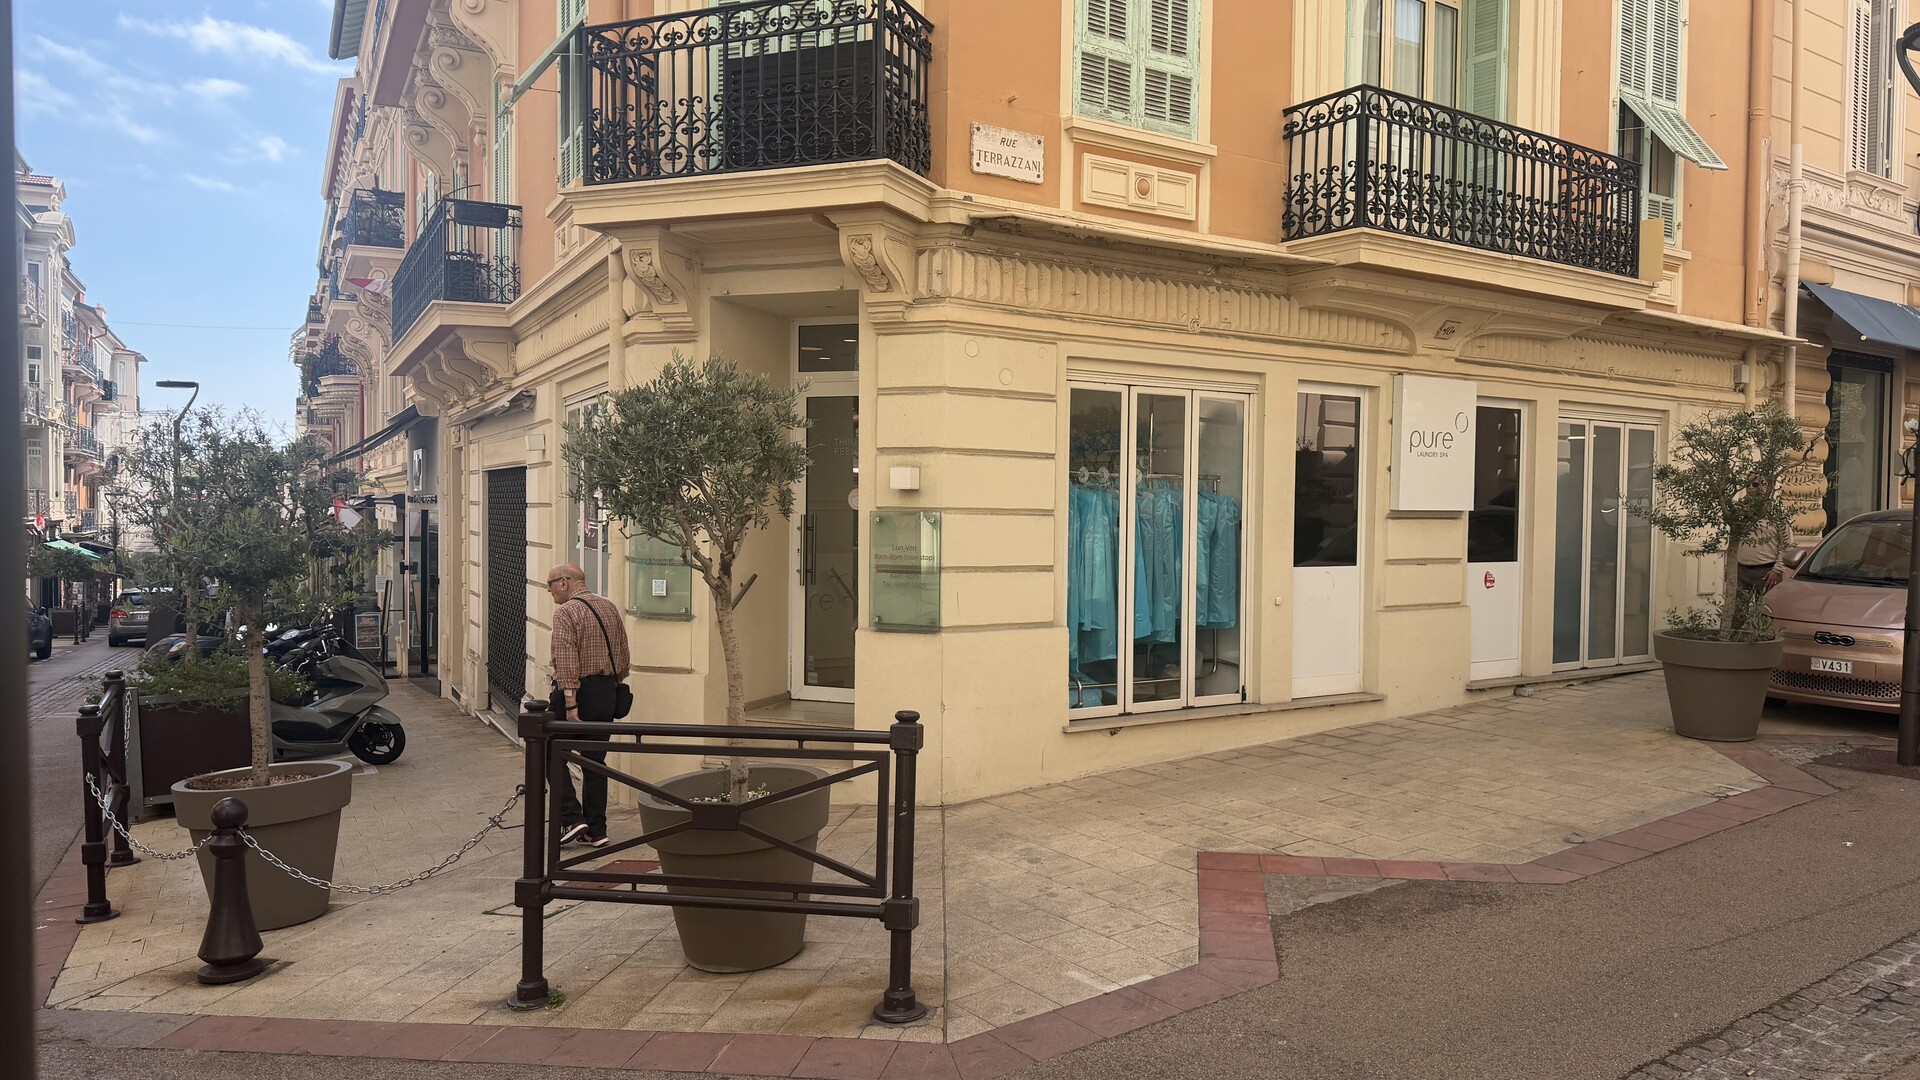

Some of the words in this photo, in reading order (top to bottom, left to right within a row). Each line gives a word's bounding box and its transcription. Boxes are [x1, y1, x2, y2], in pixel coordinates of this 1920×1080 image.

[999, 137, 1018, 148] RUE
[976, 149, 1041, 173] TERRAZZANI
[1409, 430, 1454, 453] pure
[1814, 631, 1855, 646] 500
[1821, 660, 1849, 672] V431
